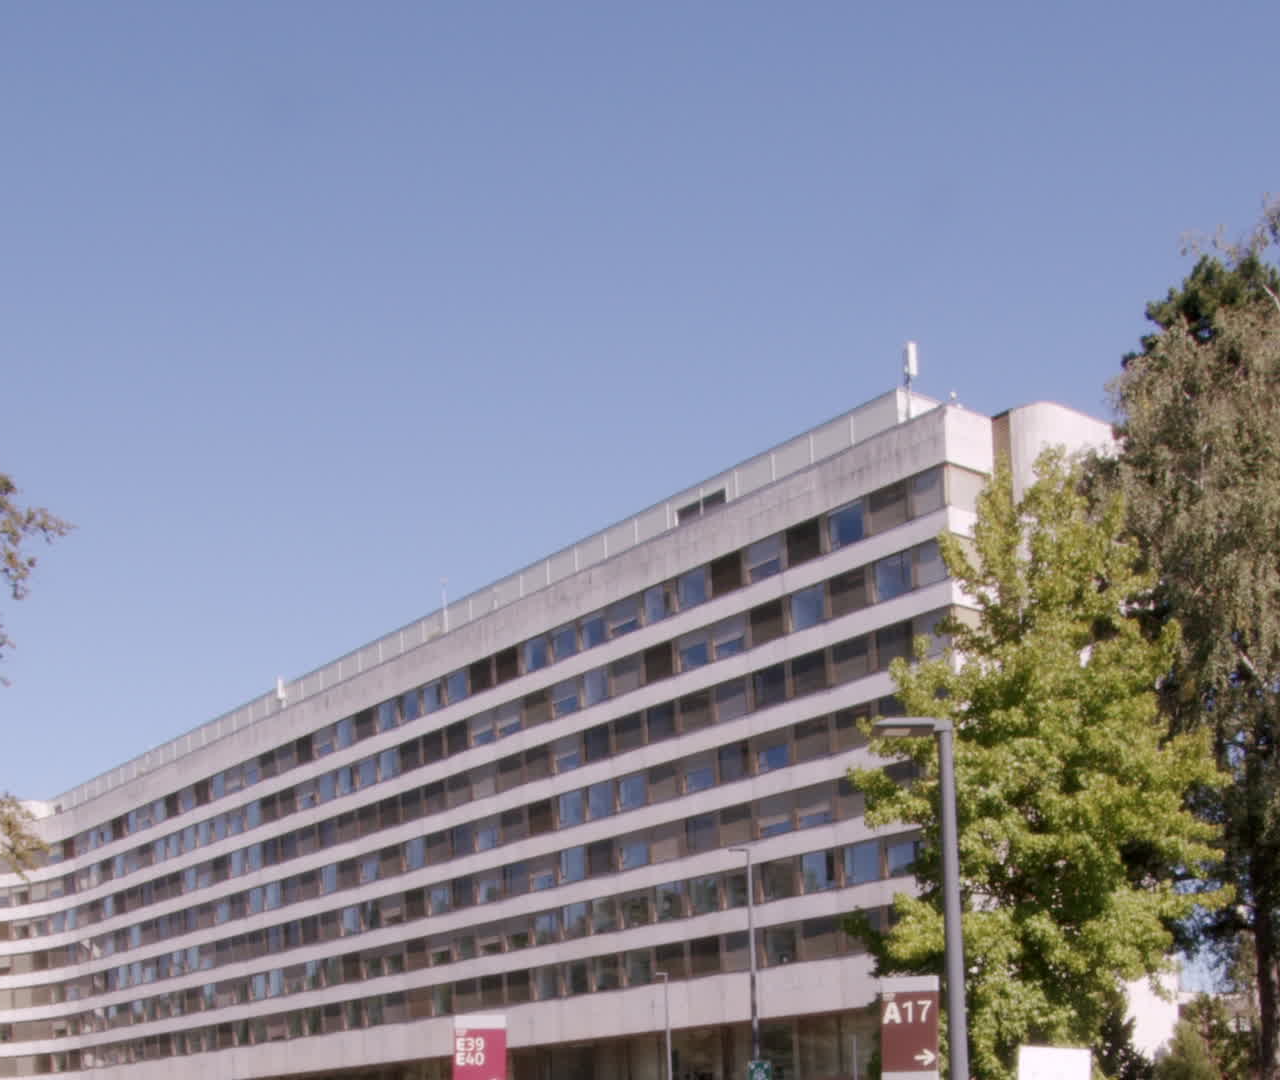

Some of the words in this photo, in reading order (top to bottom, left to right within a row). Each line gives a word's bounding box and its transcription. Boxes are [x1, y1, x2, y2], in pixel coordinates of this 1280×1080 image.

[882, 1000, 932, 1024] A17
[456, 1037, 485, 1051] E39
[456, 1052, 485, 1066] E40
